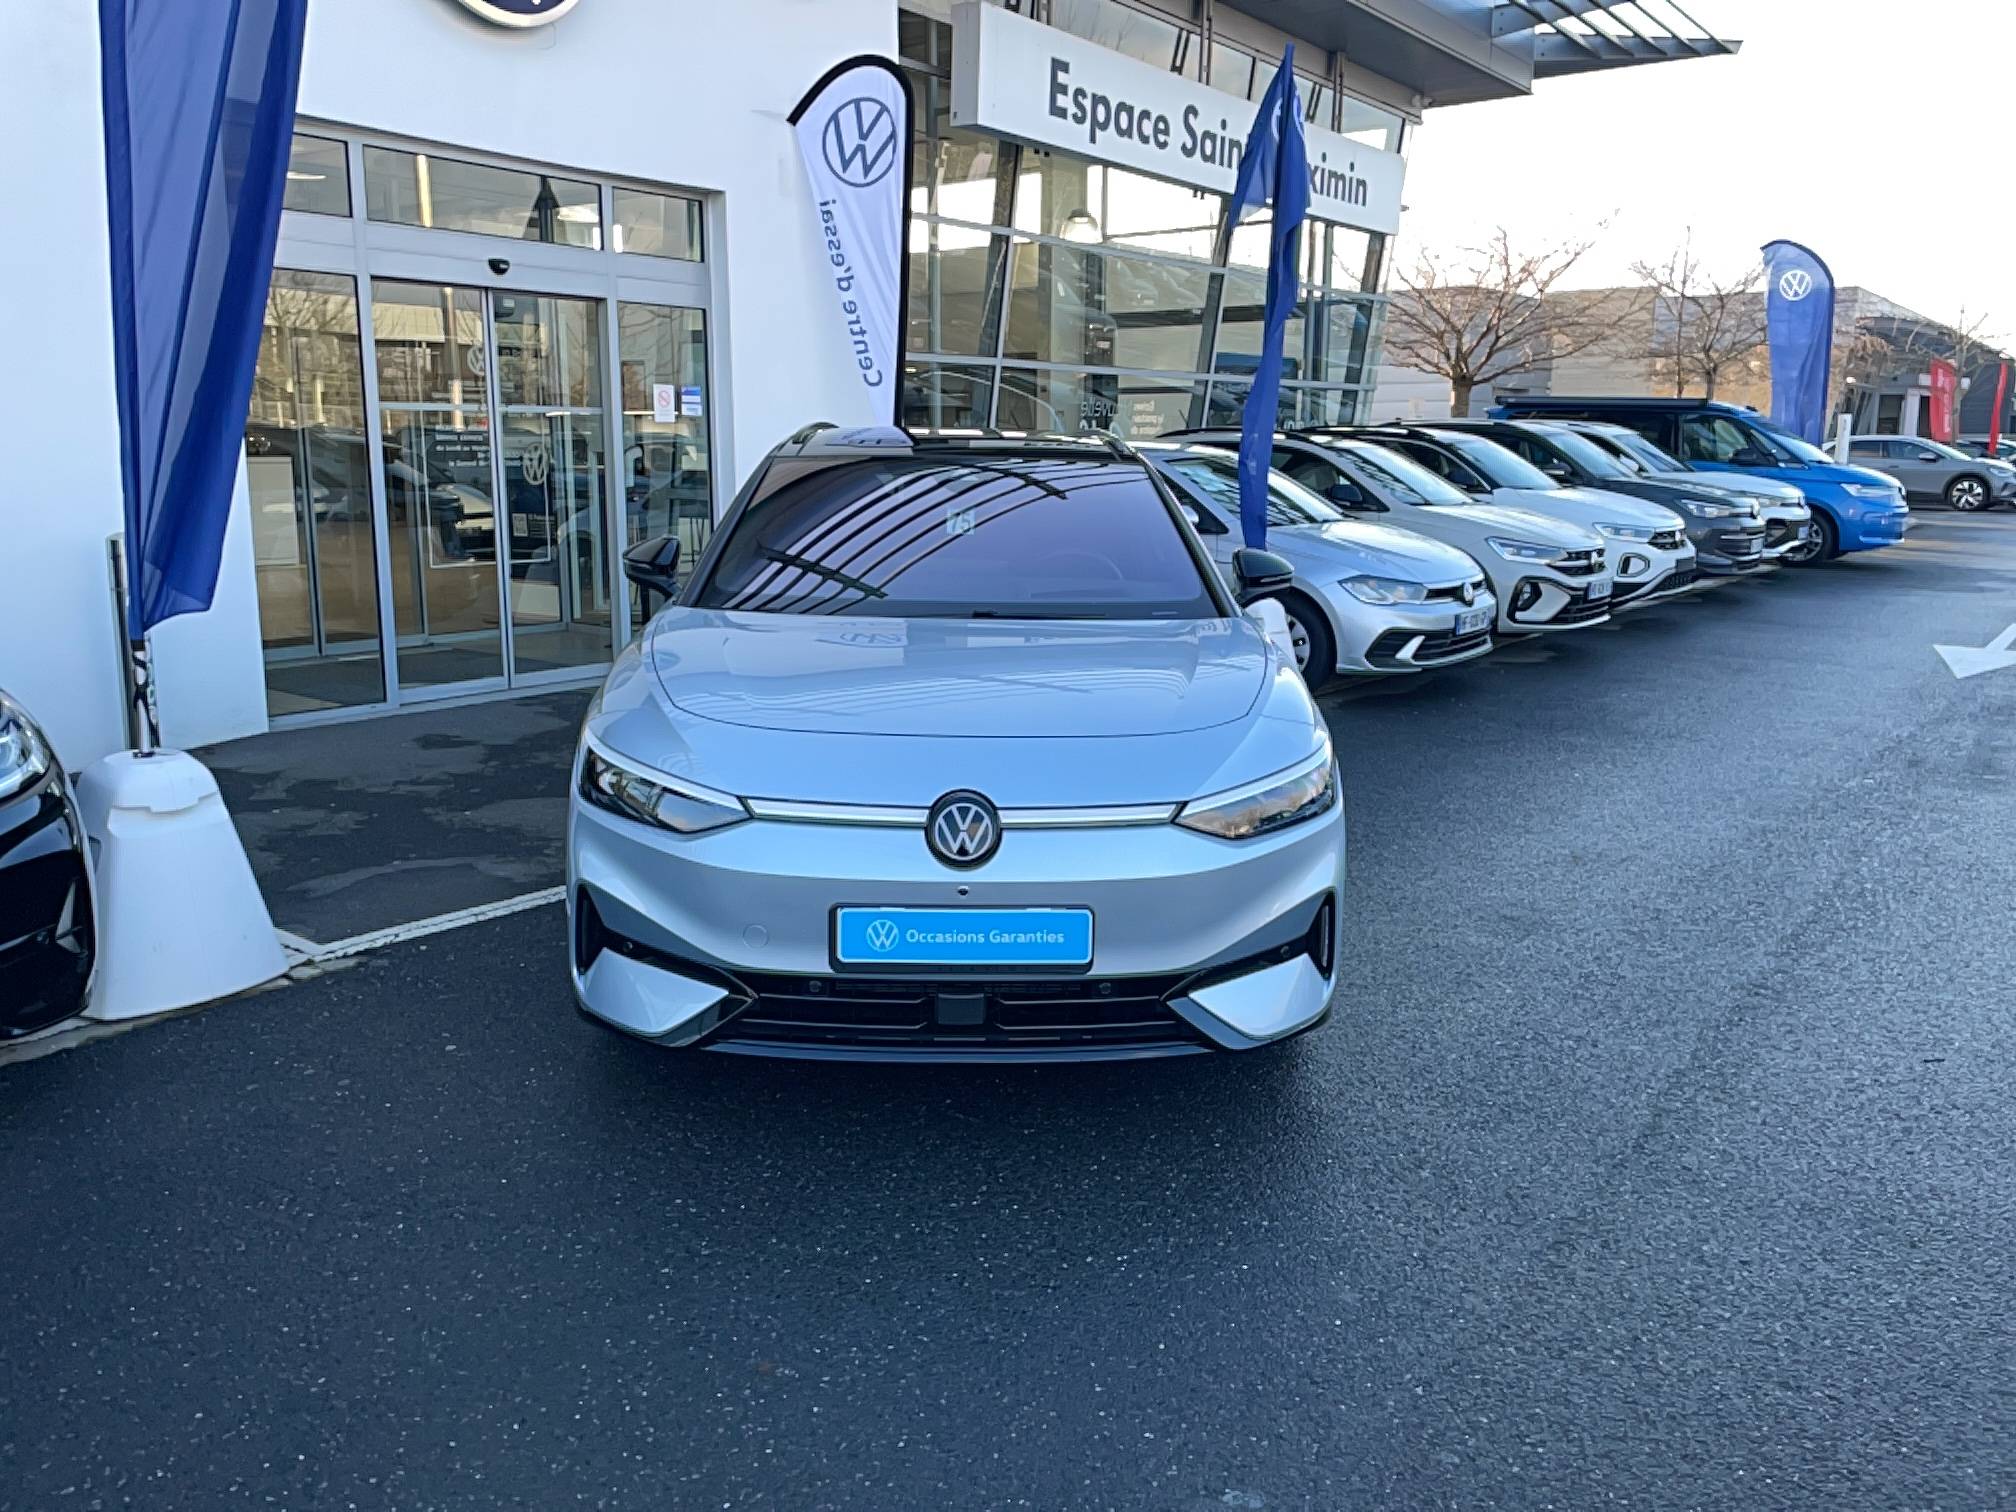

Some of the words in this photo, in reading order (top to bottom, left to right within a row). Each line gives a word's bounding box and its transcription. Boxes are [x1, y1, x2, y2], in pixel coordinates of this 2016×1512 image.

[1049, 56, 1170, 150] Espace
[1181, 104, 1243, 170] Sain
[1307, 152, 1367, 207] ximin
[906, 929, 984, 943] Occasions
[989, 929, 1065, 943] Garanties
